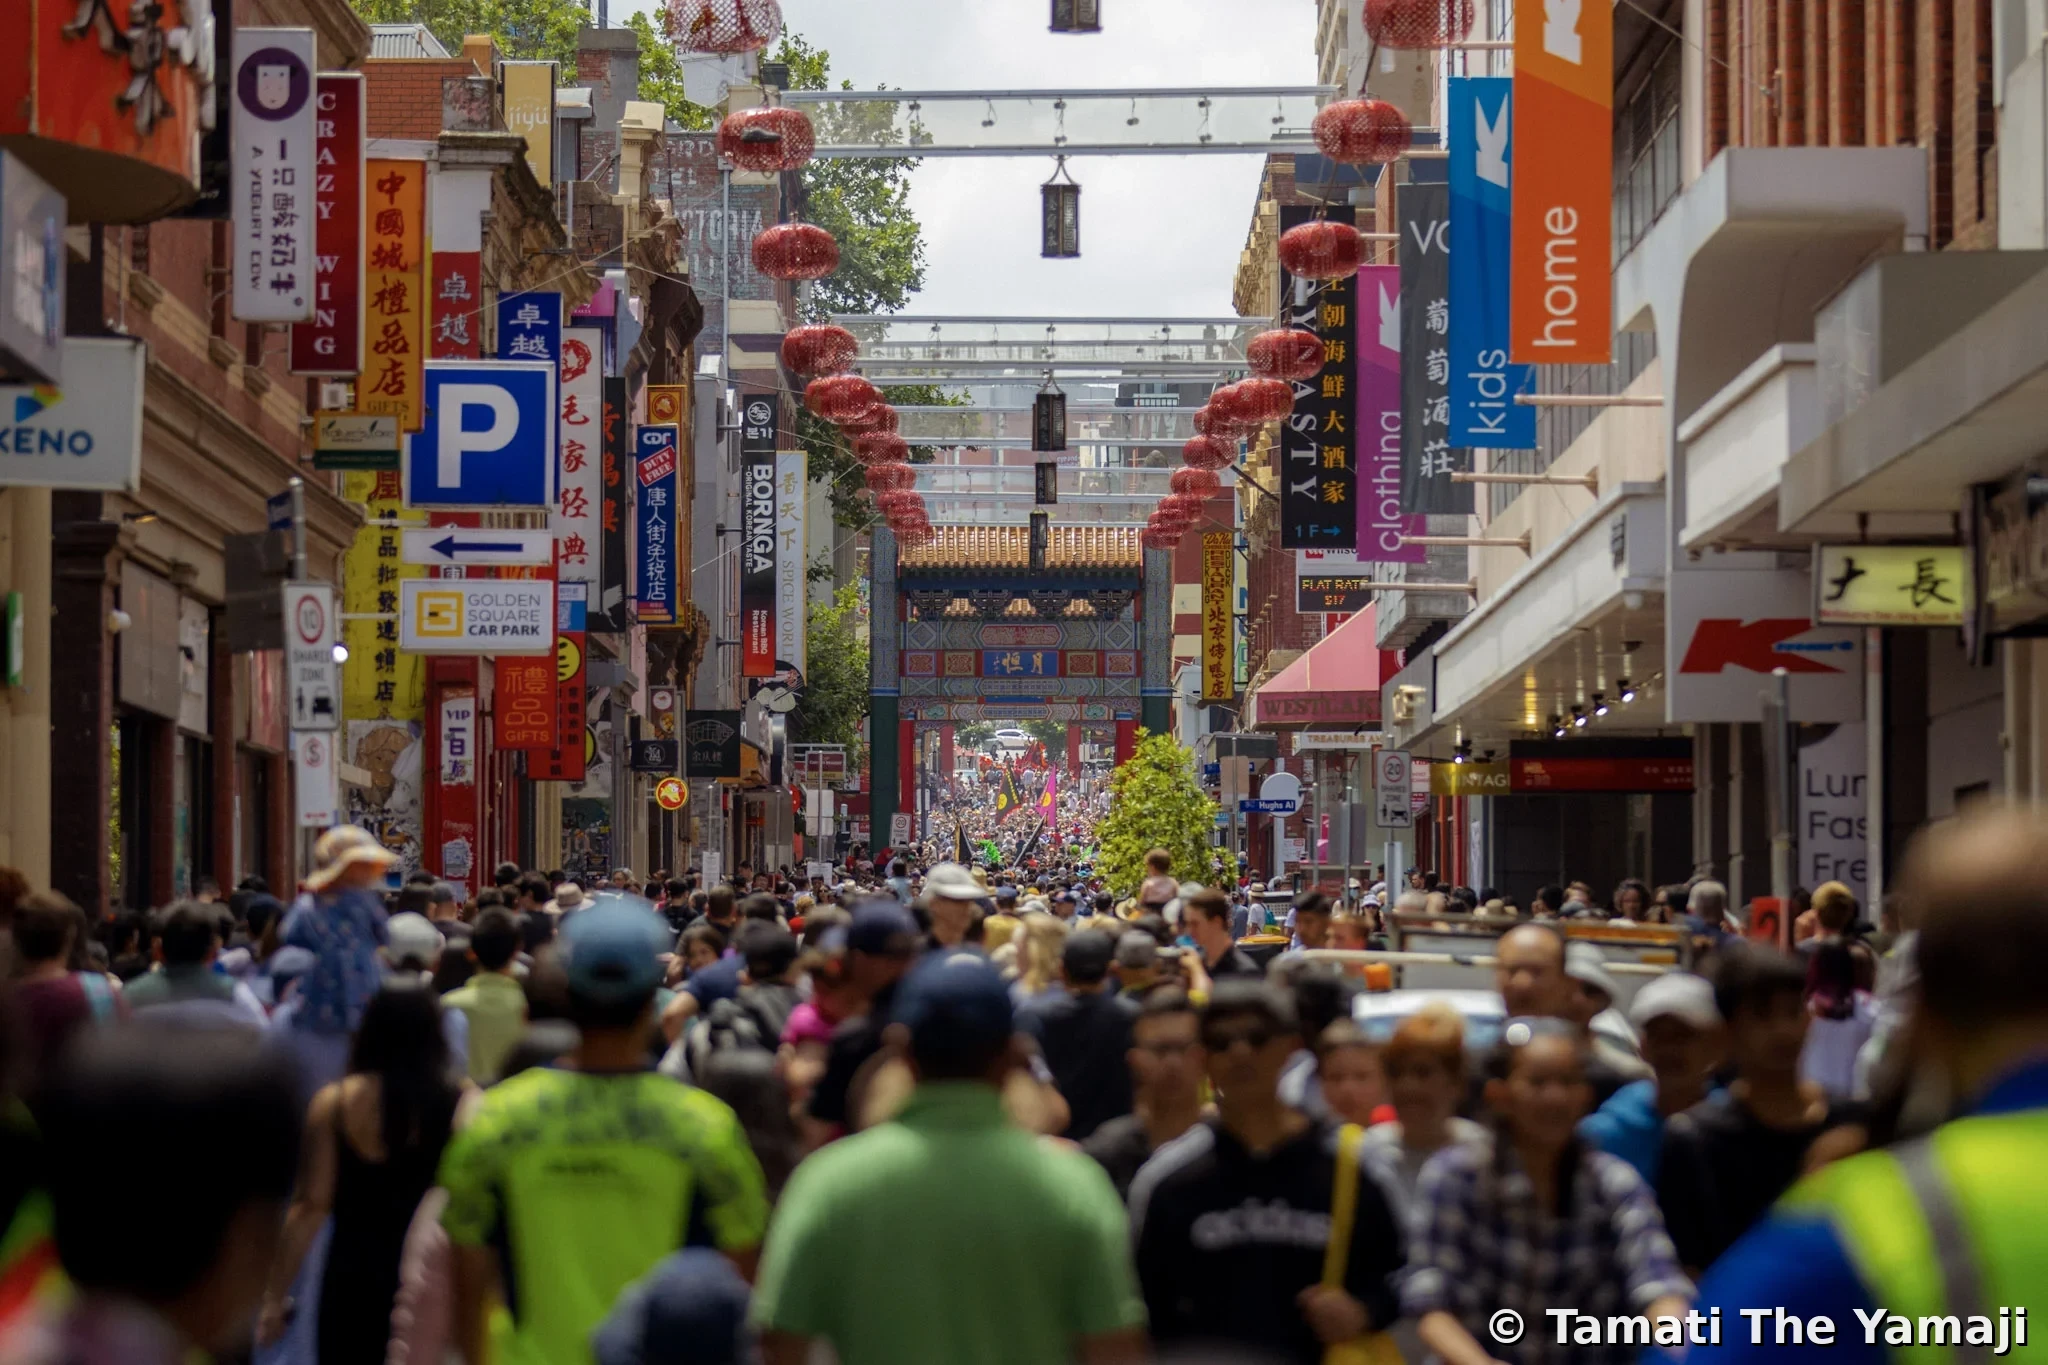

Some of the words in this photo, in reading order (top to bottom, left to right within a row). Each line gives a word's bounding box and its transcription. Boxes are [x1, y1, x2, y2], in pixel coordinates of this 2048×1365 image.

[251, 145, 264, 159] A
[316, 93, 337, 220] CRAZY
[250, 168, 263, 241] YOGURT
[250, 250, 262, 290] COW
[368, 169, 411, 397] 中國城禮品店
[1532, 206, 1578, 347] home
[314, 255, 340, 355] WING
[508, 303, 551, 359] 卓越
[367, 400, 410, 411] GIFTS
[1467, 349, 1507, 434] kids
[438, 384, 520, 488] P
[643, 452, 672, 472] DUTY
[645, 462, 674, 483] FREE
[559, 394, 591, 566] 毛家经典
[752, 463, 775, 574] BORNGA
[645, 487, 668, 601] 唐人街免税店
[782, 560, 795, 603] SPICE
[1302, 579, 1333, 591] FLAT
[467, 593, 541, 607] GOLDEN
[467, 609, 540, 624] SQUARE
[468, 624, 498, 636] CAR
[502, 624, 540, 636] PARK
[760, 609, 768, 636] Korean
[752, 609, 760, 656] Restaurant
[760, 637, 768, 655] BBQ
[446, 709, 471, 720] VIP
[504, 730, 550, 742] GIFTS
[1387, 763, 1401, 775] 20
[1443, 769, 1511, 788] VINTAG
[1259, 801, 1283, 811] Hughs
[1813, 853, 1867, 882] Fre
